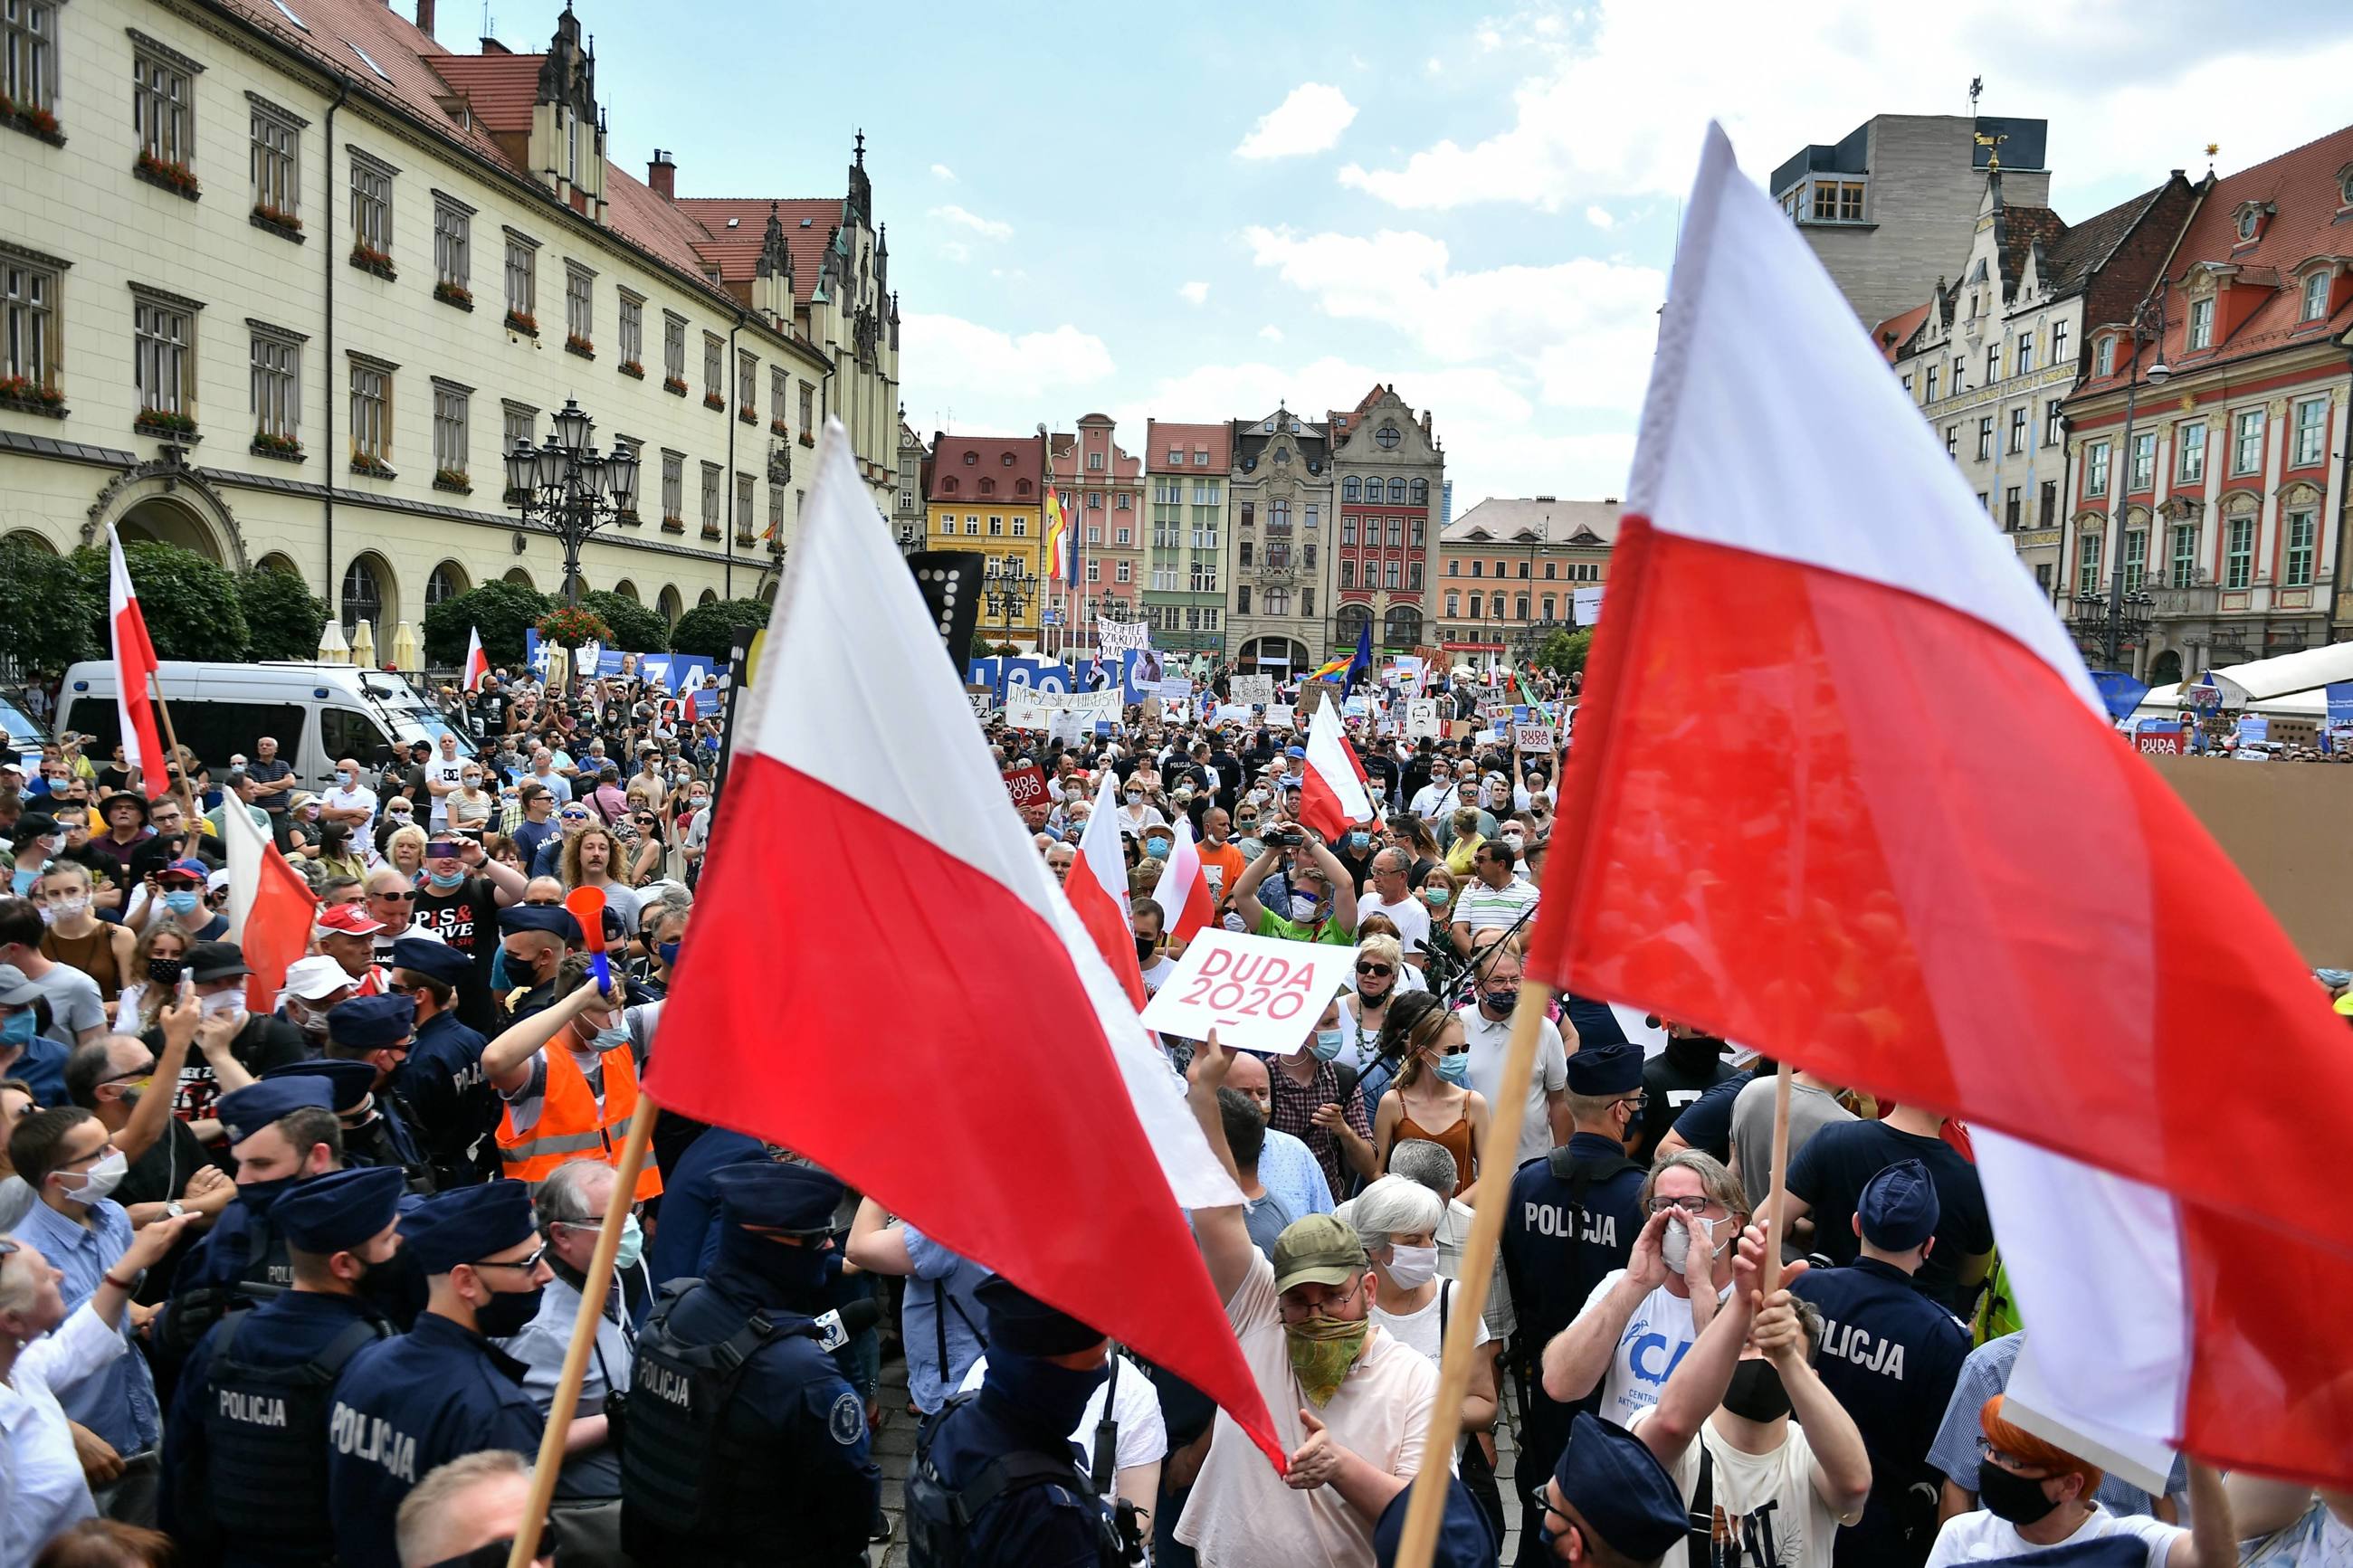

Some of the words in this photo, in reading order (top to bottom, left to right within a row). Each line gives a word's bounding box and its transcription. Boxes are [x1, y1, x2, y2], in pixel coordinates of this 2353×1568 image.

[1096, 619, 1143, 636] PEDOFILE
[1488, 708, 1512, 717] LOV
[1521, 730, 1548, 738] DUDA
[2141, 738, 2177, 749] DUDA
[1005, 774, 1038, 791] DUDA
[1198, 947, 1315, 992] DUDA
[1179, 977, 1304, 1020] 2020
[1525, 1202, 1616, 1248] POLICJA
[638, 1357, 689, 1408] POLICJA
[220, 1389, 286, 1427] POLICJA
[1629, 1389, 1659, 1405] CENTRU
[329, 1401, 416, 1483] POLICJA
